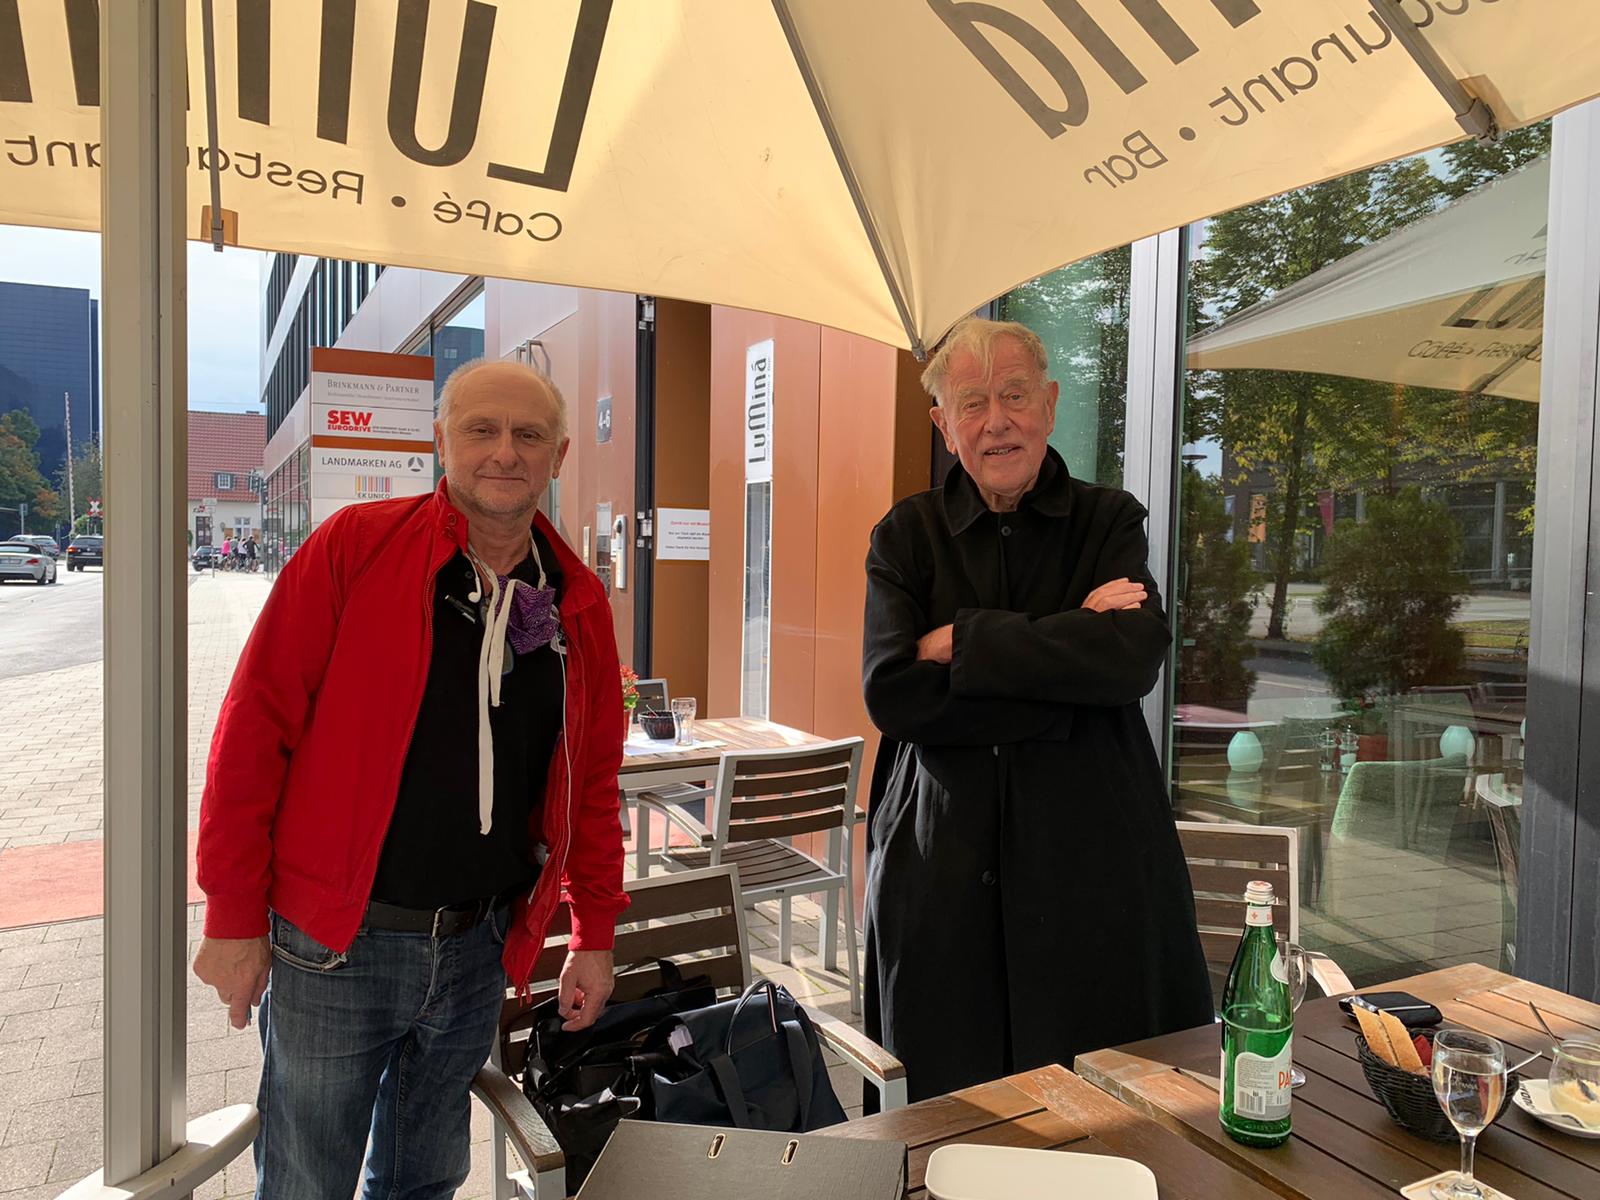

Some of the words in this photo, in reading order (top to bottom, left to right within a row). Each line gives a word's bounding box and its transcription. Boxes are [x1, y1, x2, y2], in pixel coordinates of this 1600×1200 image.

[385, 383, 420, 394] PARTNER
[327, 410, 373, 426] SEW
[327, 424, 372, 433] EURODRIVE
[322, 456, 387, 468] LANDMARKEN
[388, 460, 402, 469] AG
[1278, 1070, 1293, 1090] PA
